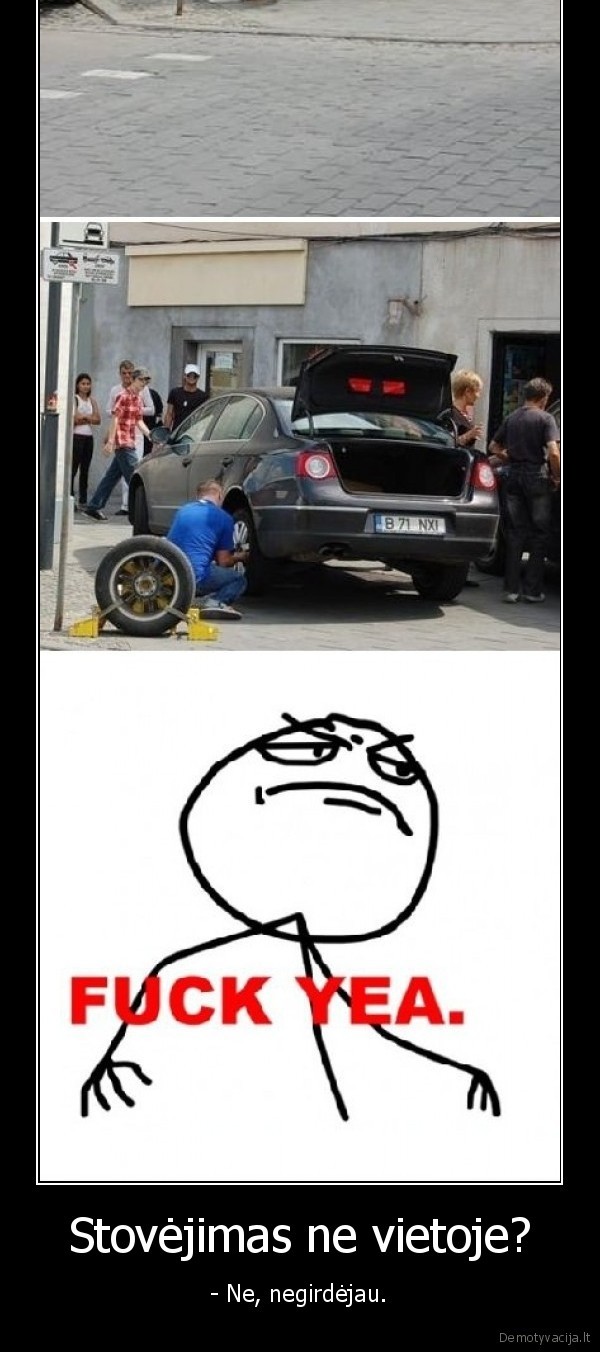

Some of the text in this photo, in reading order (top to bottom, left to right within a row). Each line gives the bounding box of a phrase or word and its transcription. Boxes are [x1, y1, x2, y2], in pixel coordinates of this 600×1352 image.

[385, 517, 439, 531] B 71 NXI
